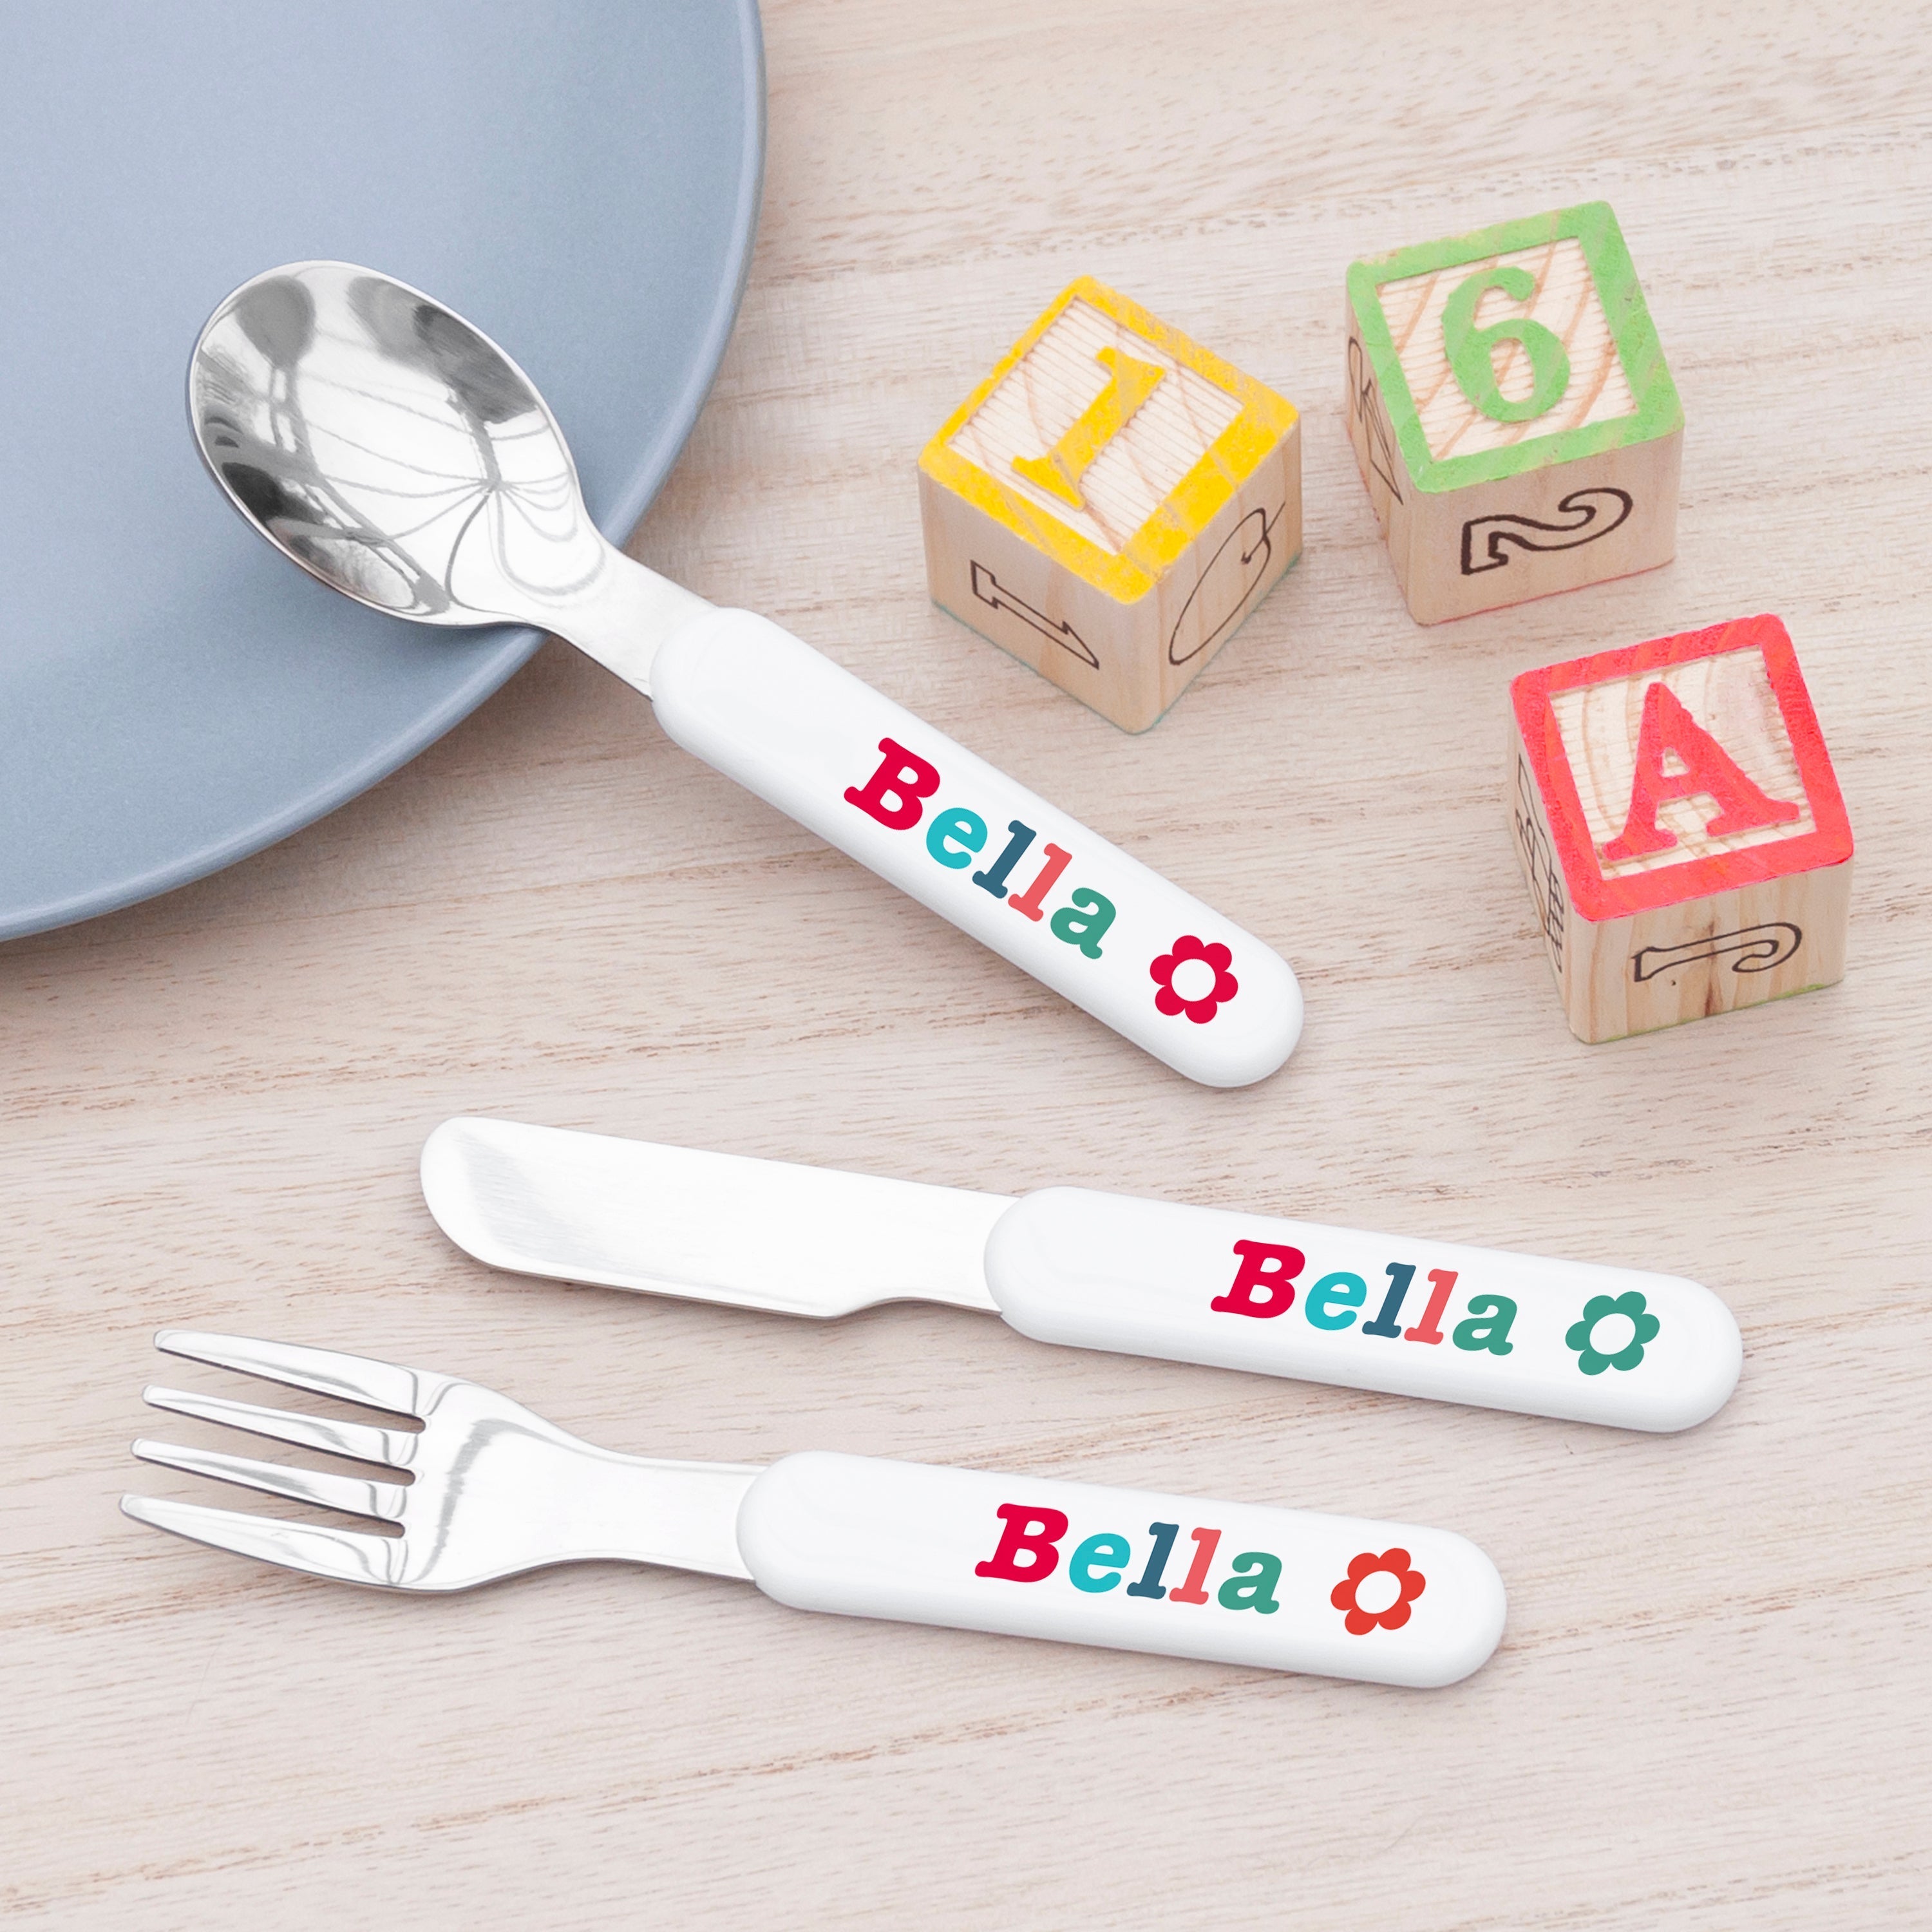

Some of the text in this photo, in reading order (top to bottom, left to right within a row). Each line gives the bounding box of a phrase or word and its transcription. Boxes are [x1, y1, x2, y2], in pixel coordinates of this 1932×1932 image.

[1441, 266, 1571, 424] 6
[1461, 488, 1633, 575] 2
[971, 560, 1099, 670] 1
[1602, 681, 1799, 862] A
[844, 737, 1115, 959] Bella
[1211, 1239, 1517, 1355] Bella
[975, 1503, 1282, 1614] Bella
